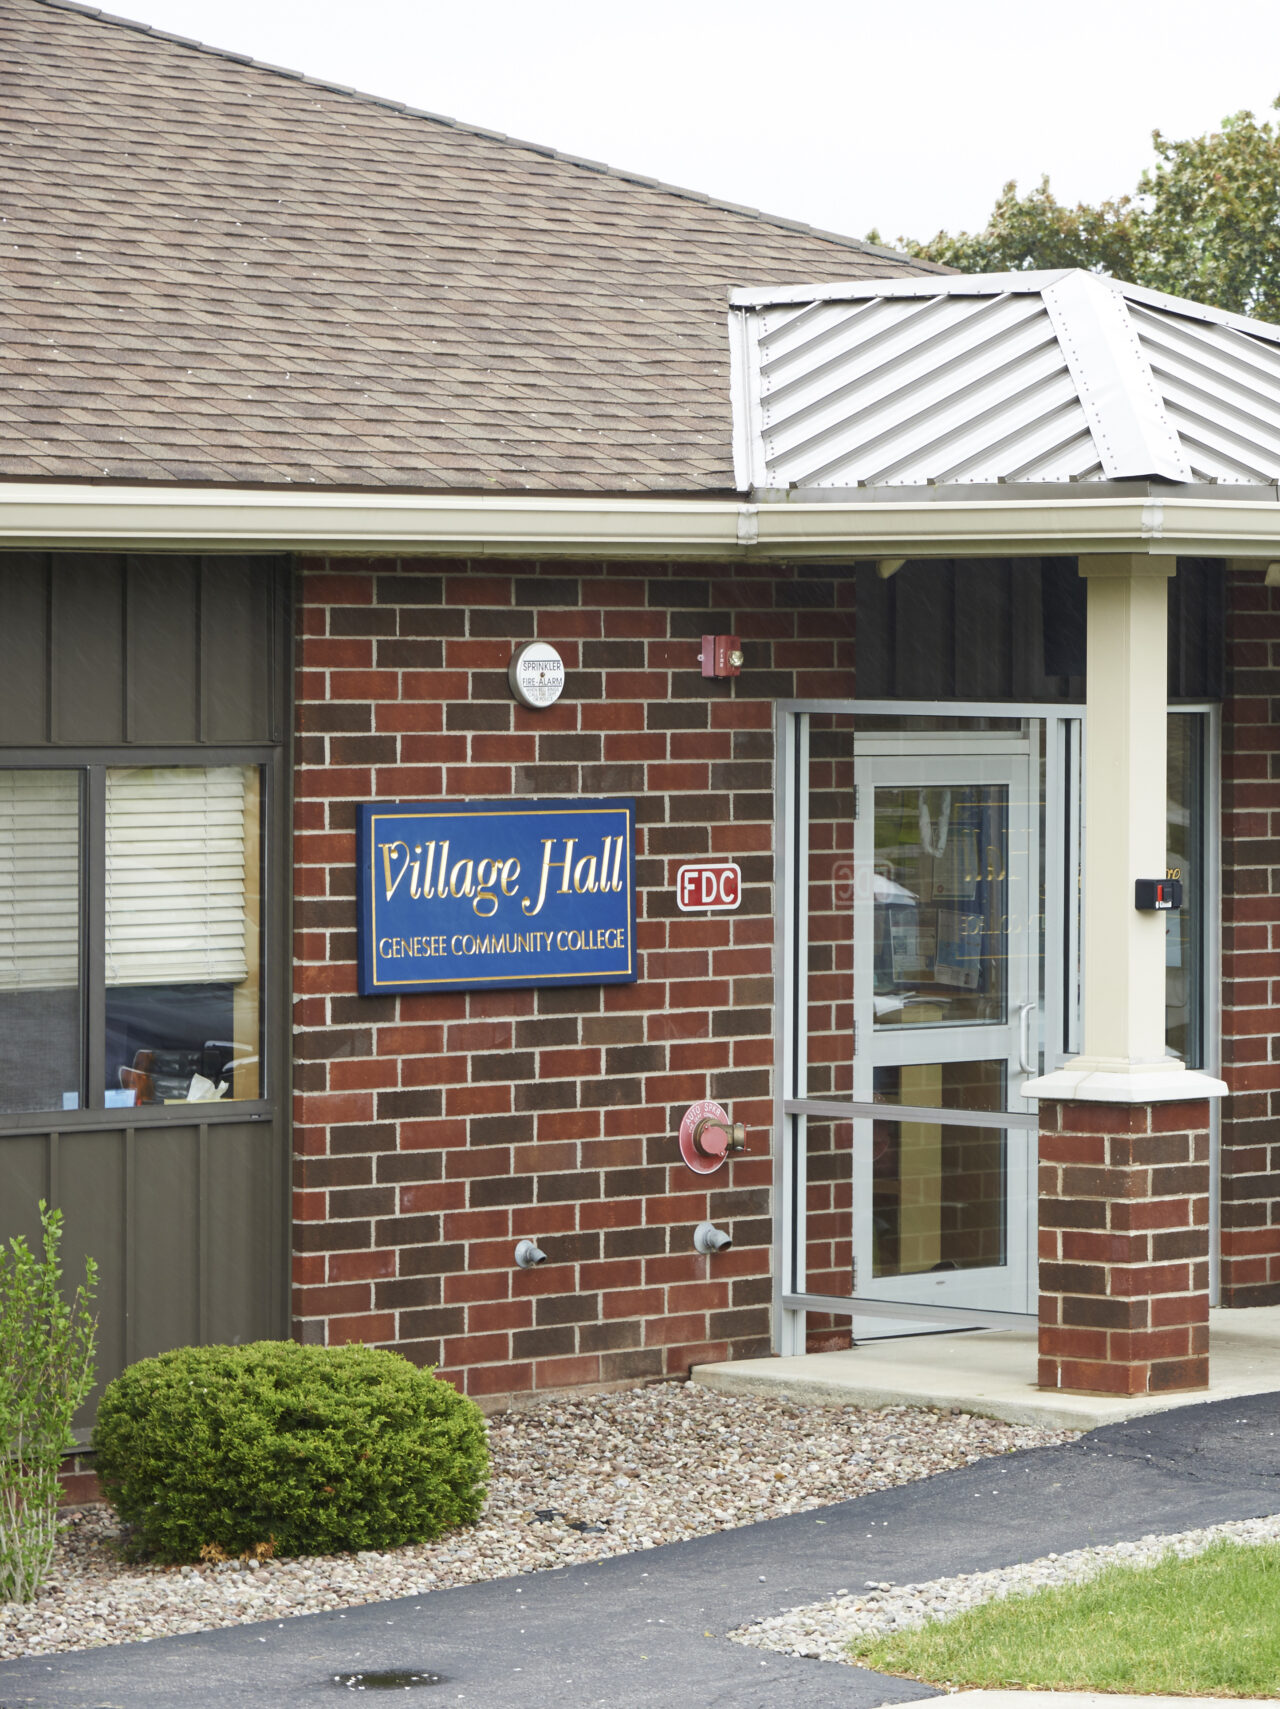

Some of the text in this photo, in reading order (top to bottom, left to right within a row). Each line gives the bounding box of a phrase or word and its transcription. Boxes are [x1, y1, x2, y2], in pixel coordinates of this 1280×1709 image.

[523, 662, 561, 671] SPRINKLER
[378, 835, 623, 917] Village Hall
[684, 870, 735, 904] FDC
[379, 929, 625, 958] GENESEE COMMUNITY COLLEGE
[685, 1105, 701, 1126] AUTO
